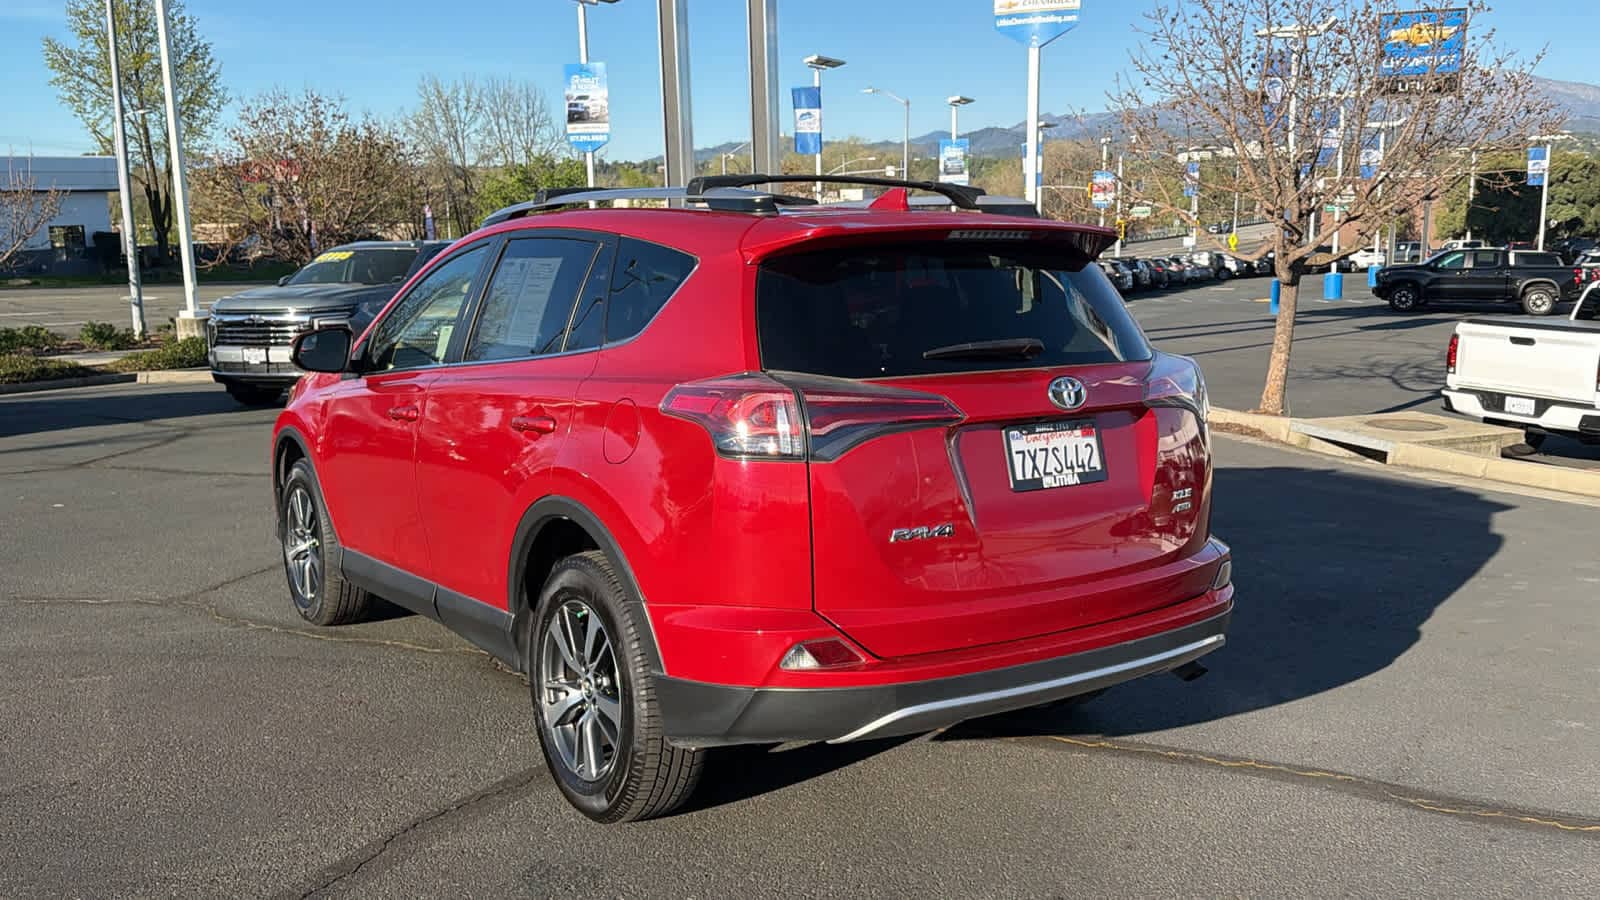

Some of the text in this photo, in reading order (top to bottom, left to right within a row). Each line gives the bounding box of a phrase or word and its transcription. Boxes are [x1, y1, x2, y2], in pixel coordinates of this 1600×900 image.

[1025, 430, 1076, 445] California
[1015, 442, 1097, 479] 7XZS442
[1171, 487, 1192, 501] XLE
[889, 523, 954, 543] RAV4
